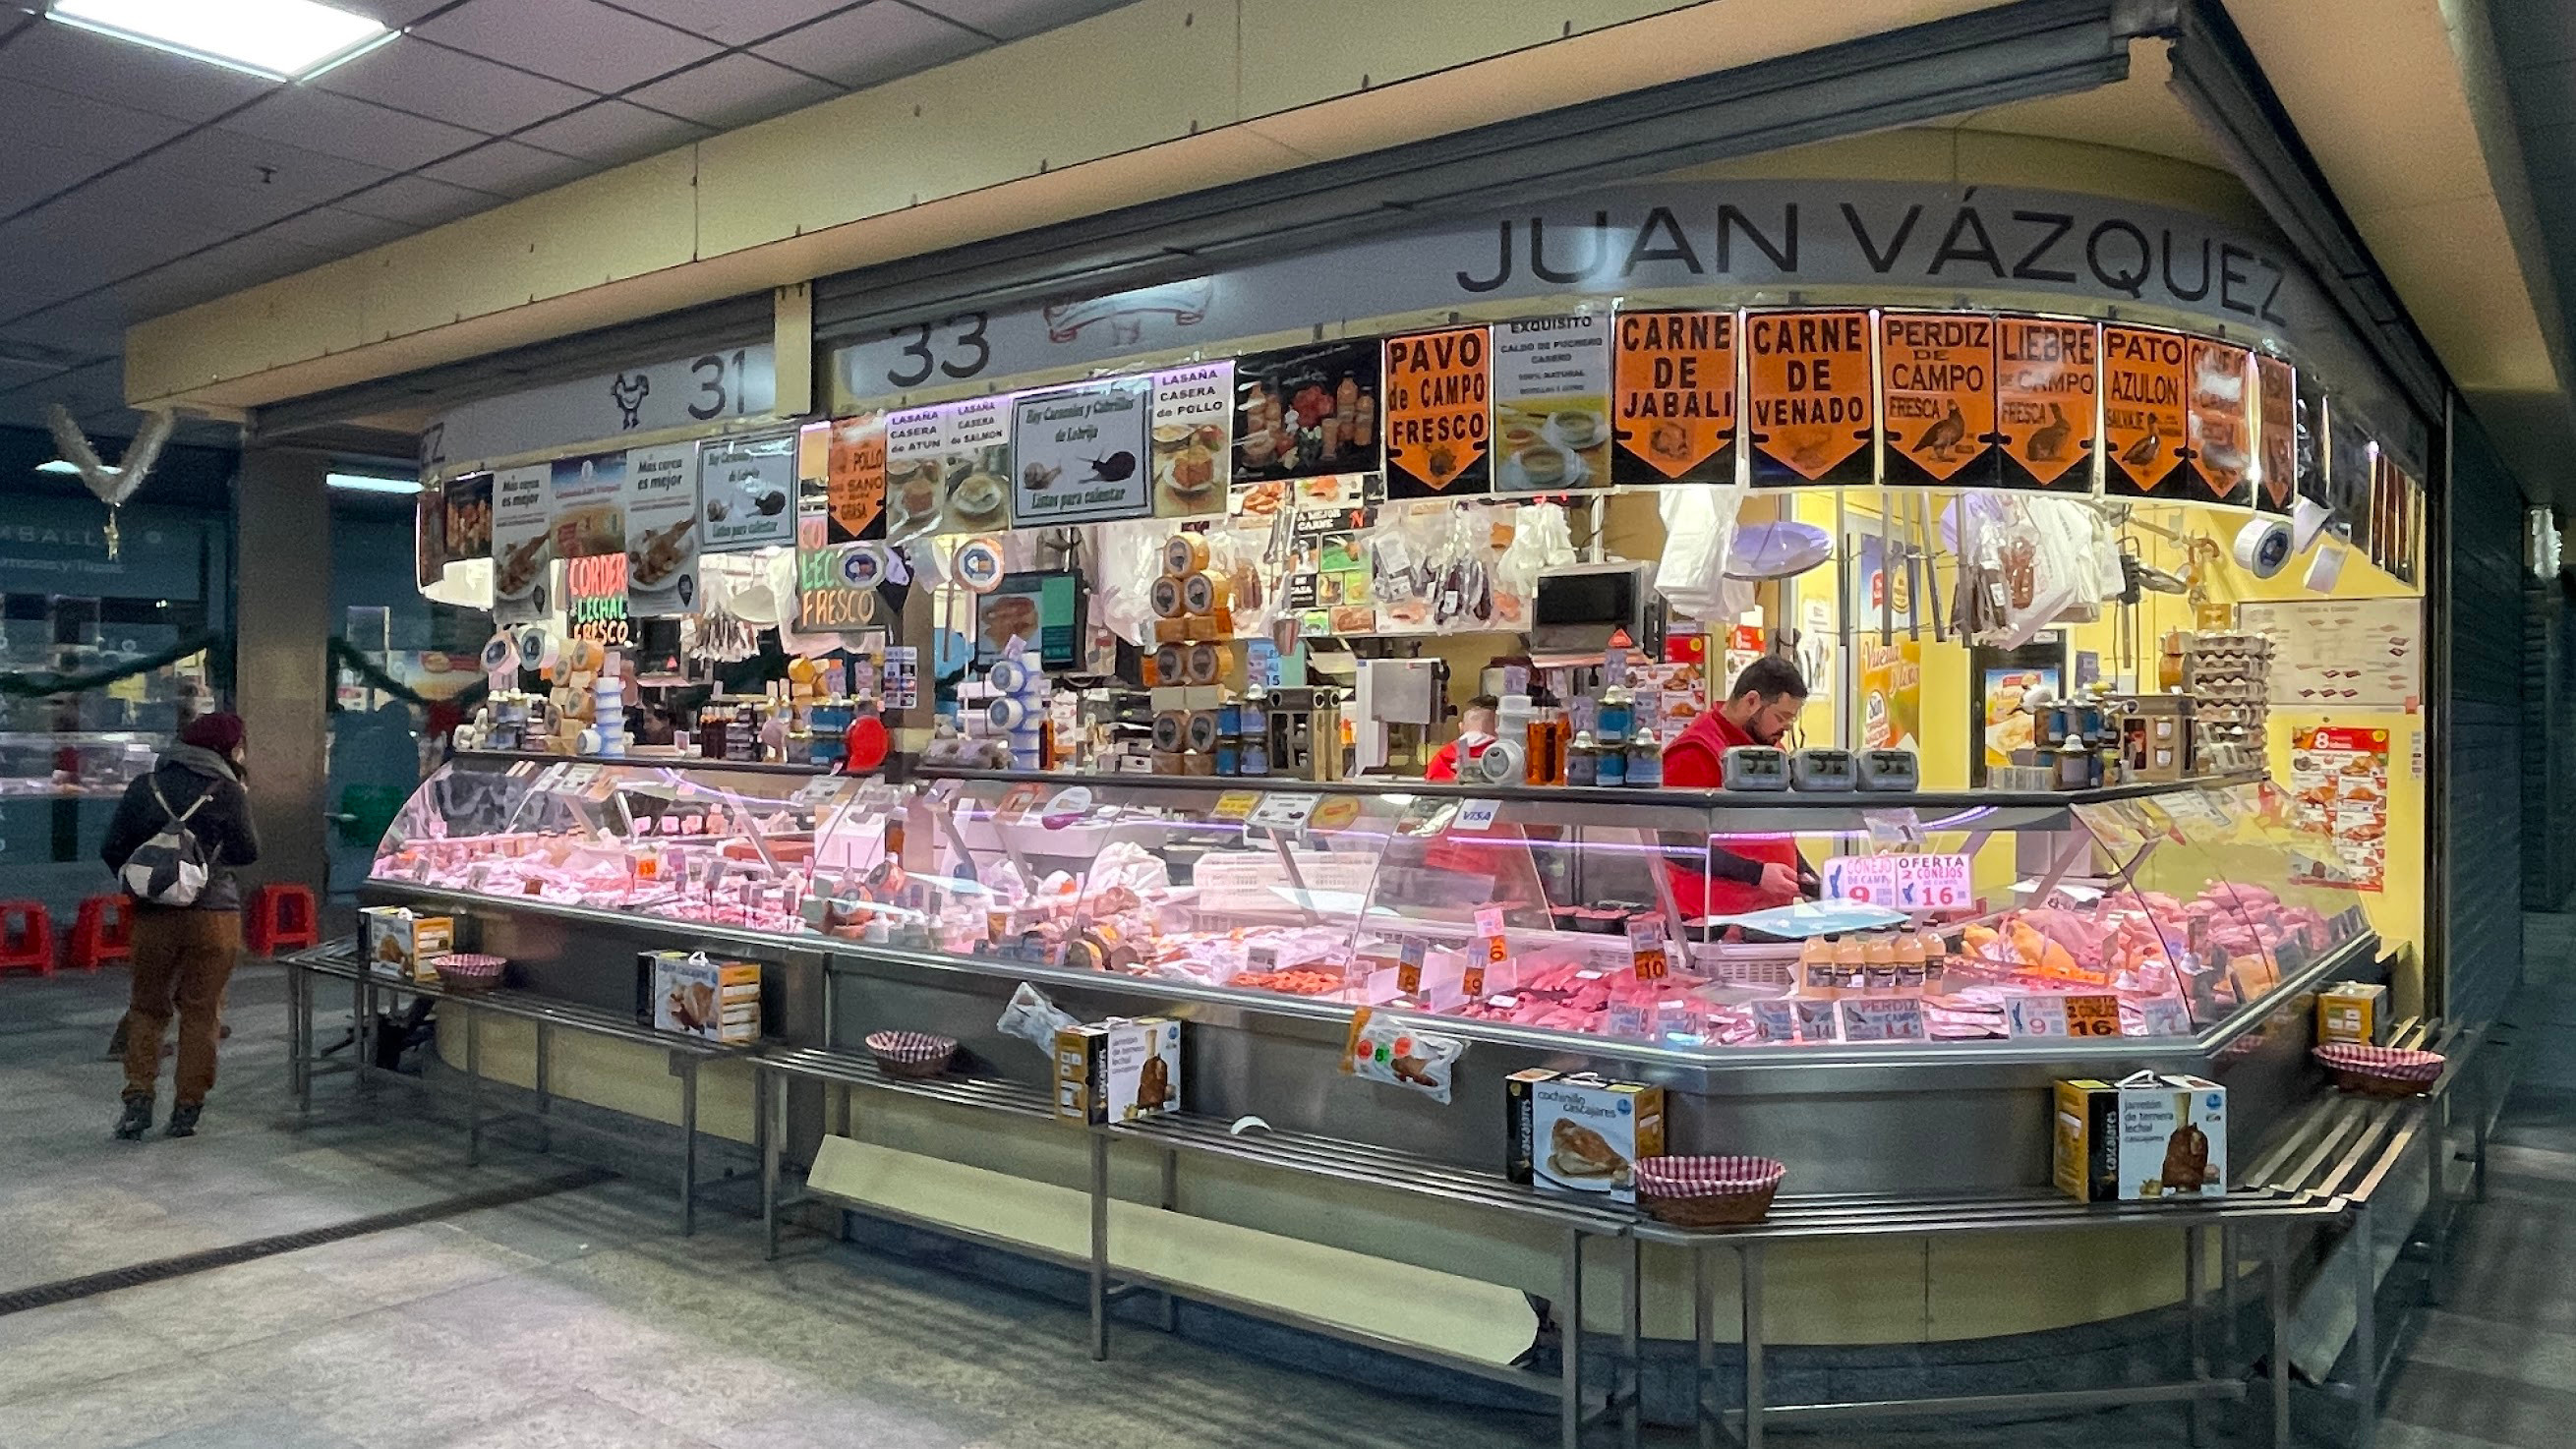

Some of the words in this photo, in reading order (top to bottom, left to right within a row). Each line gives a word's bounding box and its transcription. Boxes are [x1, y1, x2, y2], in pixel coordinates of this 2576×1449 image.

[1456, 202, 1799, 293] JUAN
[1840, 187, 2287, 328] VÁZQUEZ
[1511, 315, 1592, 334] EXQUISITO
[1622, 316, 1731, 351] CARNE
[1753, 317, 1862, 355] CARNE
[1886, 319, 1990, 349] PERDIZ
[887, 311, 989, 387] 33
[1389, 332, 1482, 375] PAVO
[1913, 349, 1950, 361] DE
[2001, 324, 2094, 365] LIEBRE
[2107, 332, 2183, 365] PATO
[688, 349, 745, 420] 31
[1162, 368, 1218, 386] LASAÑA
[1654, 356, 1698, 389] DE
[1787, 359, 1832, 391] DE
[1892, 363, 1984, 392] CAMPO
[1160, 385, 1216, 402] CASERA
[1388, 381, 1408, 412] de
[1420, 372, 1485, 408] CAMPO
[2111, 371, 2179, 407] AZULON
[1156, 407, 1172, 418] de
[1177, 401, 1223, 416] POLLO
[1623, 390, 1731, 419] JABALI
[1754, 396, 1864, 427] VENADO
[1888, 396, 1941, 420] FRESCA
[892, 410, 939, 426] LASAÑA
[1392, 412, 1485, 446] FRESCO
[890, 425, 937, 439] CASERA
[908, 438, 941, 451] ATUN
[637, 478, 648, 490] es
[650, 474, 682, 492] mejor
[577, 595, 628, 623] LECHAL
[801, 590, 875, 627] FRESCO
[2314, 731, 2329, 749] 8
[1846, 856, 1893, 875] CONEJO
[1899, 856, 1964, 869] OFERTA
[1903, 870, 1913, 880] 2
[1917, 867, 1963, 879] CONEJOS
[1848, 886, 1871, 904] 9
[1922, 886, 1954, 906] 16
[1646, 959, 1665, 980] 10
[1859, 998, 1917, 1014] PERDIZ
[2029, 1017, 2046, 1035] 9
[2071, 1019, 2114, 1036] 16
